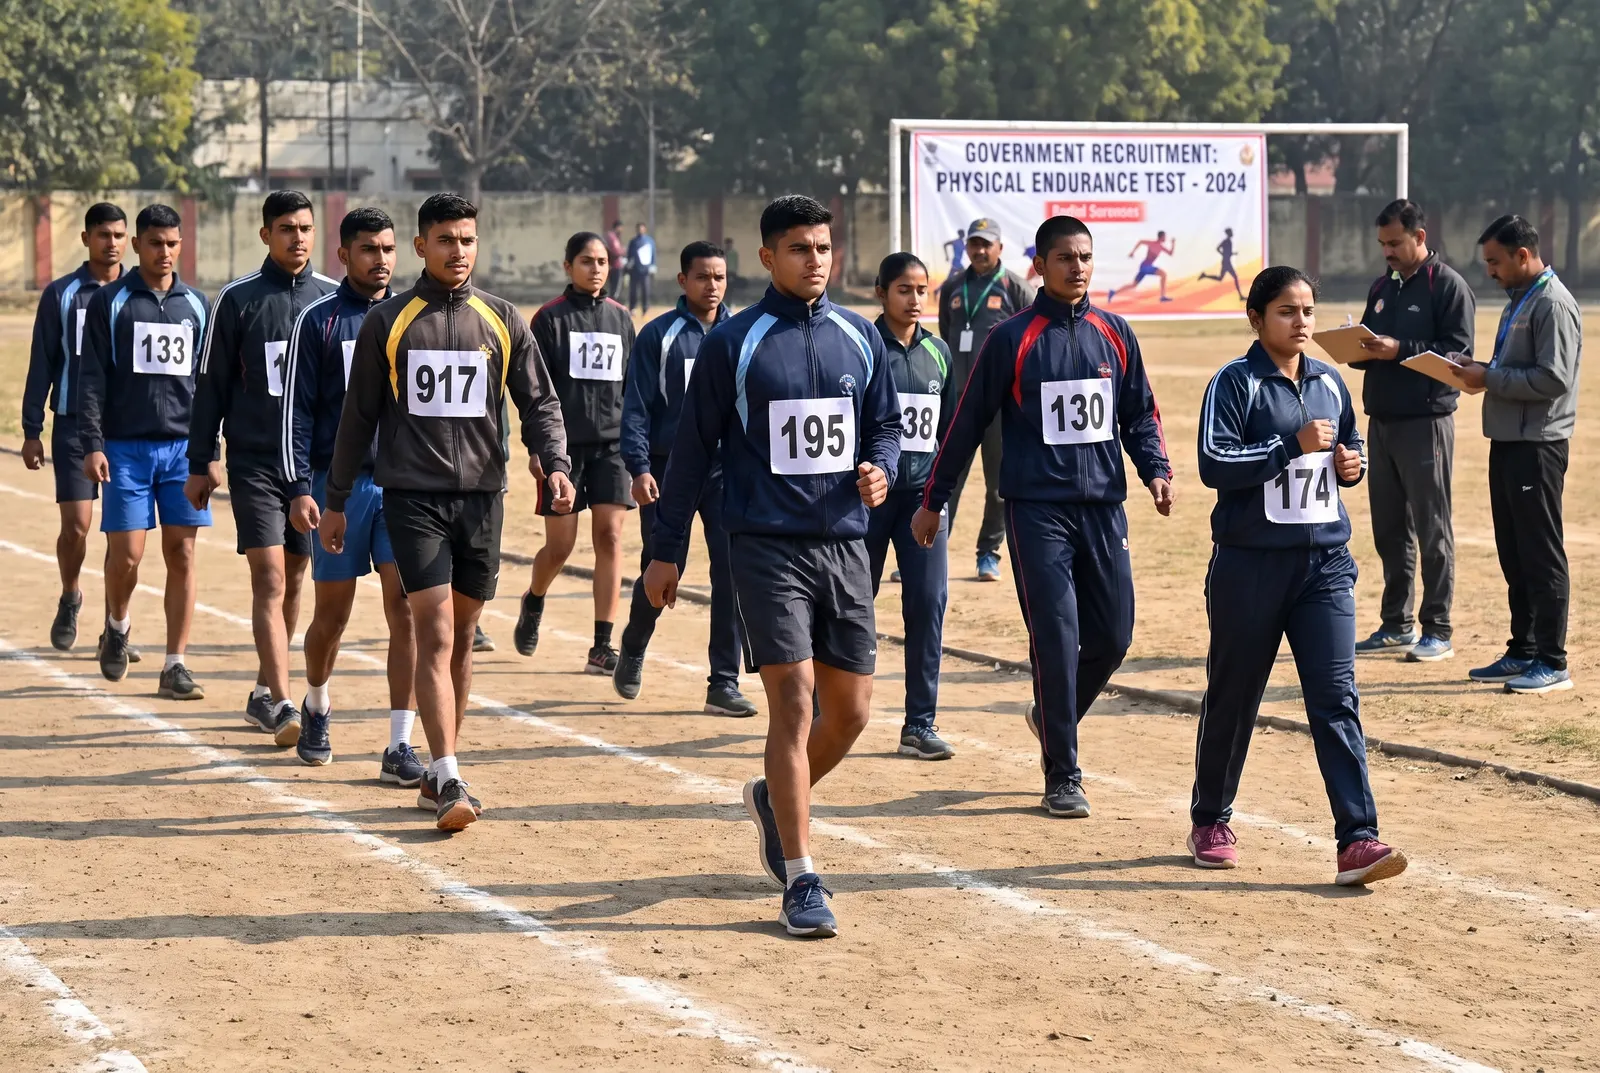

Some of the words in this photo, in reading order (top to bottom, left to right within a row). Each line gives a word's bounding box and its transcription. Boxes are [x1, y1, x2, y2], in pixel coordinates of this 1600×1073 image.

[965, 142, 1085, 163] GOVERNMENT
[1092, 143, 1218, 164] RECRUITMENT:
[936, 171, 1025, 193] PHYSICAL
[1032, 172, 1139, 193] ENDURANCE
[1145, 172, 1186, 193] TEST
[1205, 172, 1247, 193] 2024
[141, 334, 185, 365] 133
[577, 342, 616, 370] 127
[415, 364, 478, 404] 917
[902, 406, 933, 440] 38
[1050, 392, 1105, 432] 130
[781, 414, 846, 460] 195
[1274, 467, 1330, 509] 174
